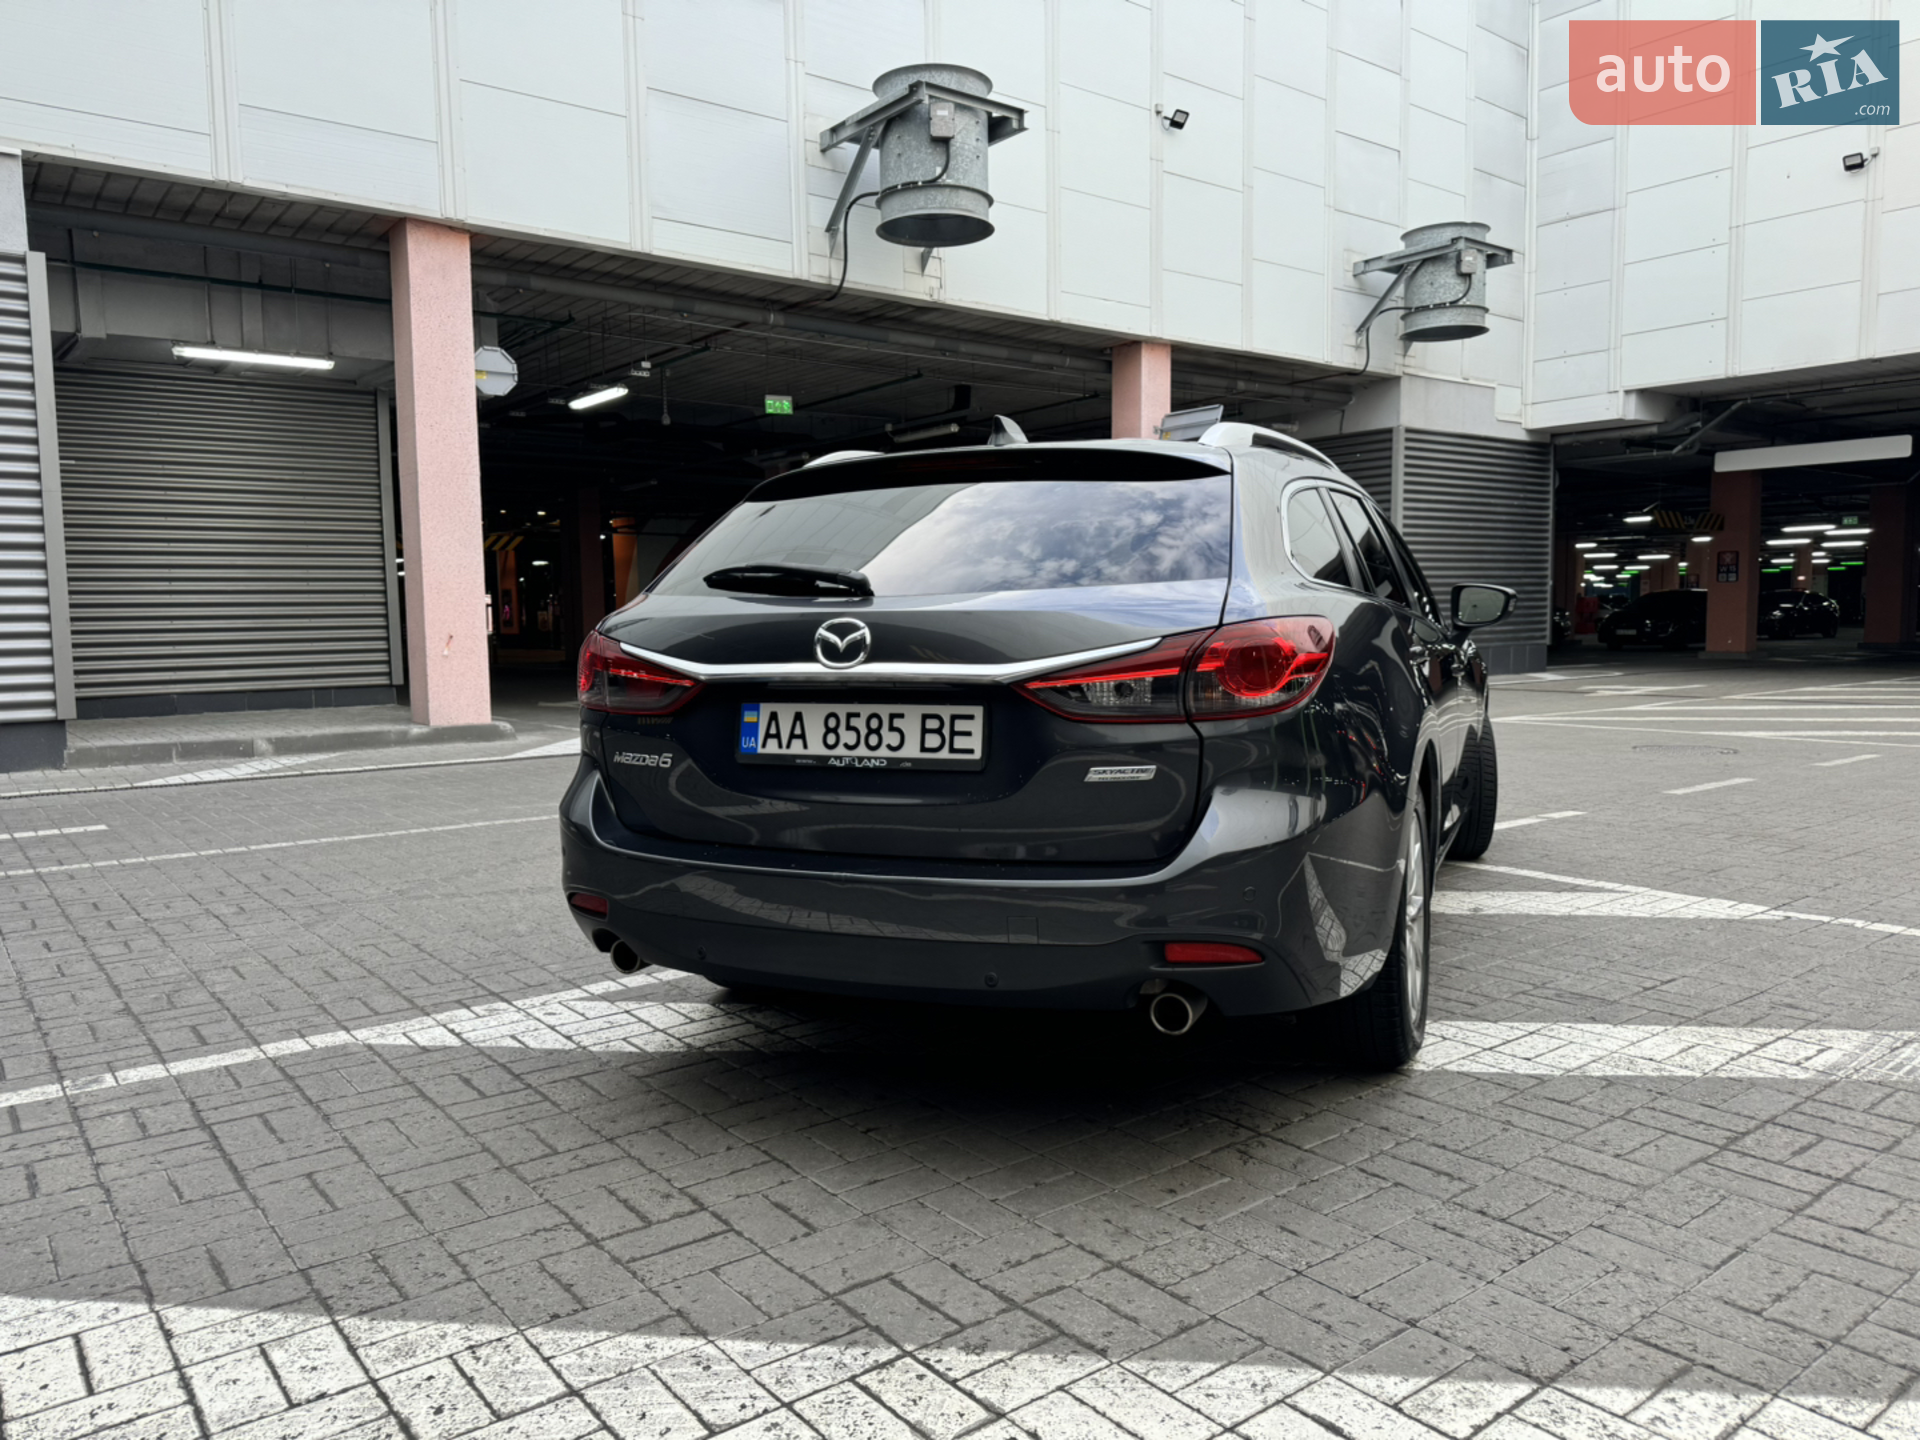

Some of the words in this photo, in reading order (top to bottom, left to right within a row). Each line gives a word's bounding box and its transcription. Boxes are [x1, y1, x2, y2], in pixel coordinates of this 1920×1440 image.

[742, 736, 757, 749] UA
[761, 711, 808, 750] AA
[822, 711, 906, 752] 8585
[919, 713, 976, 754] BE
